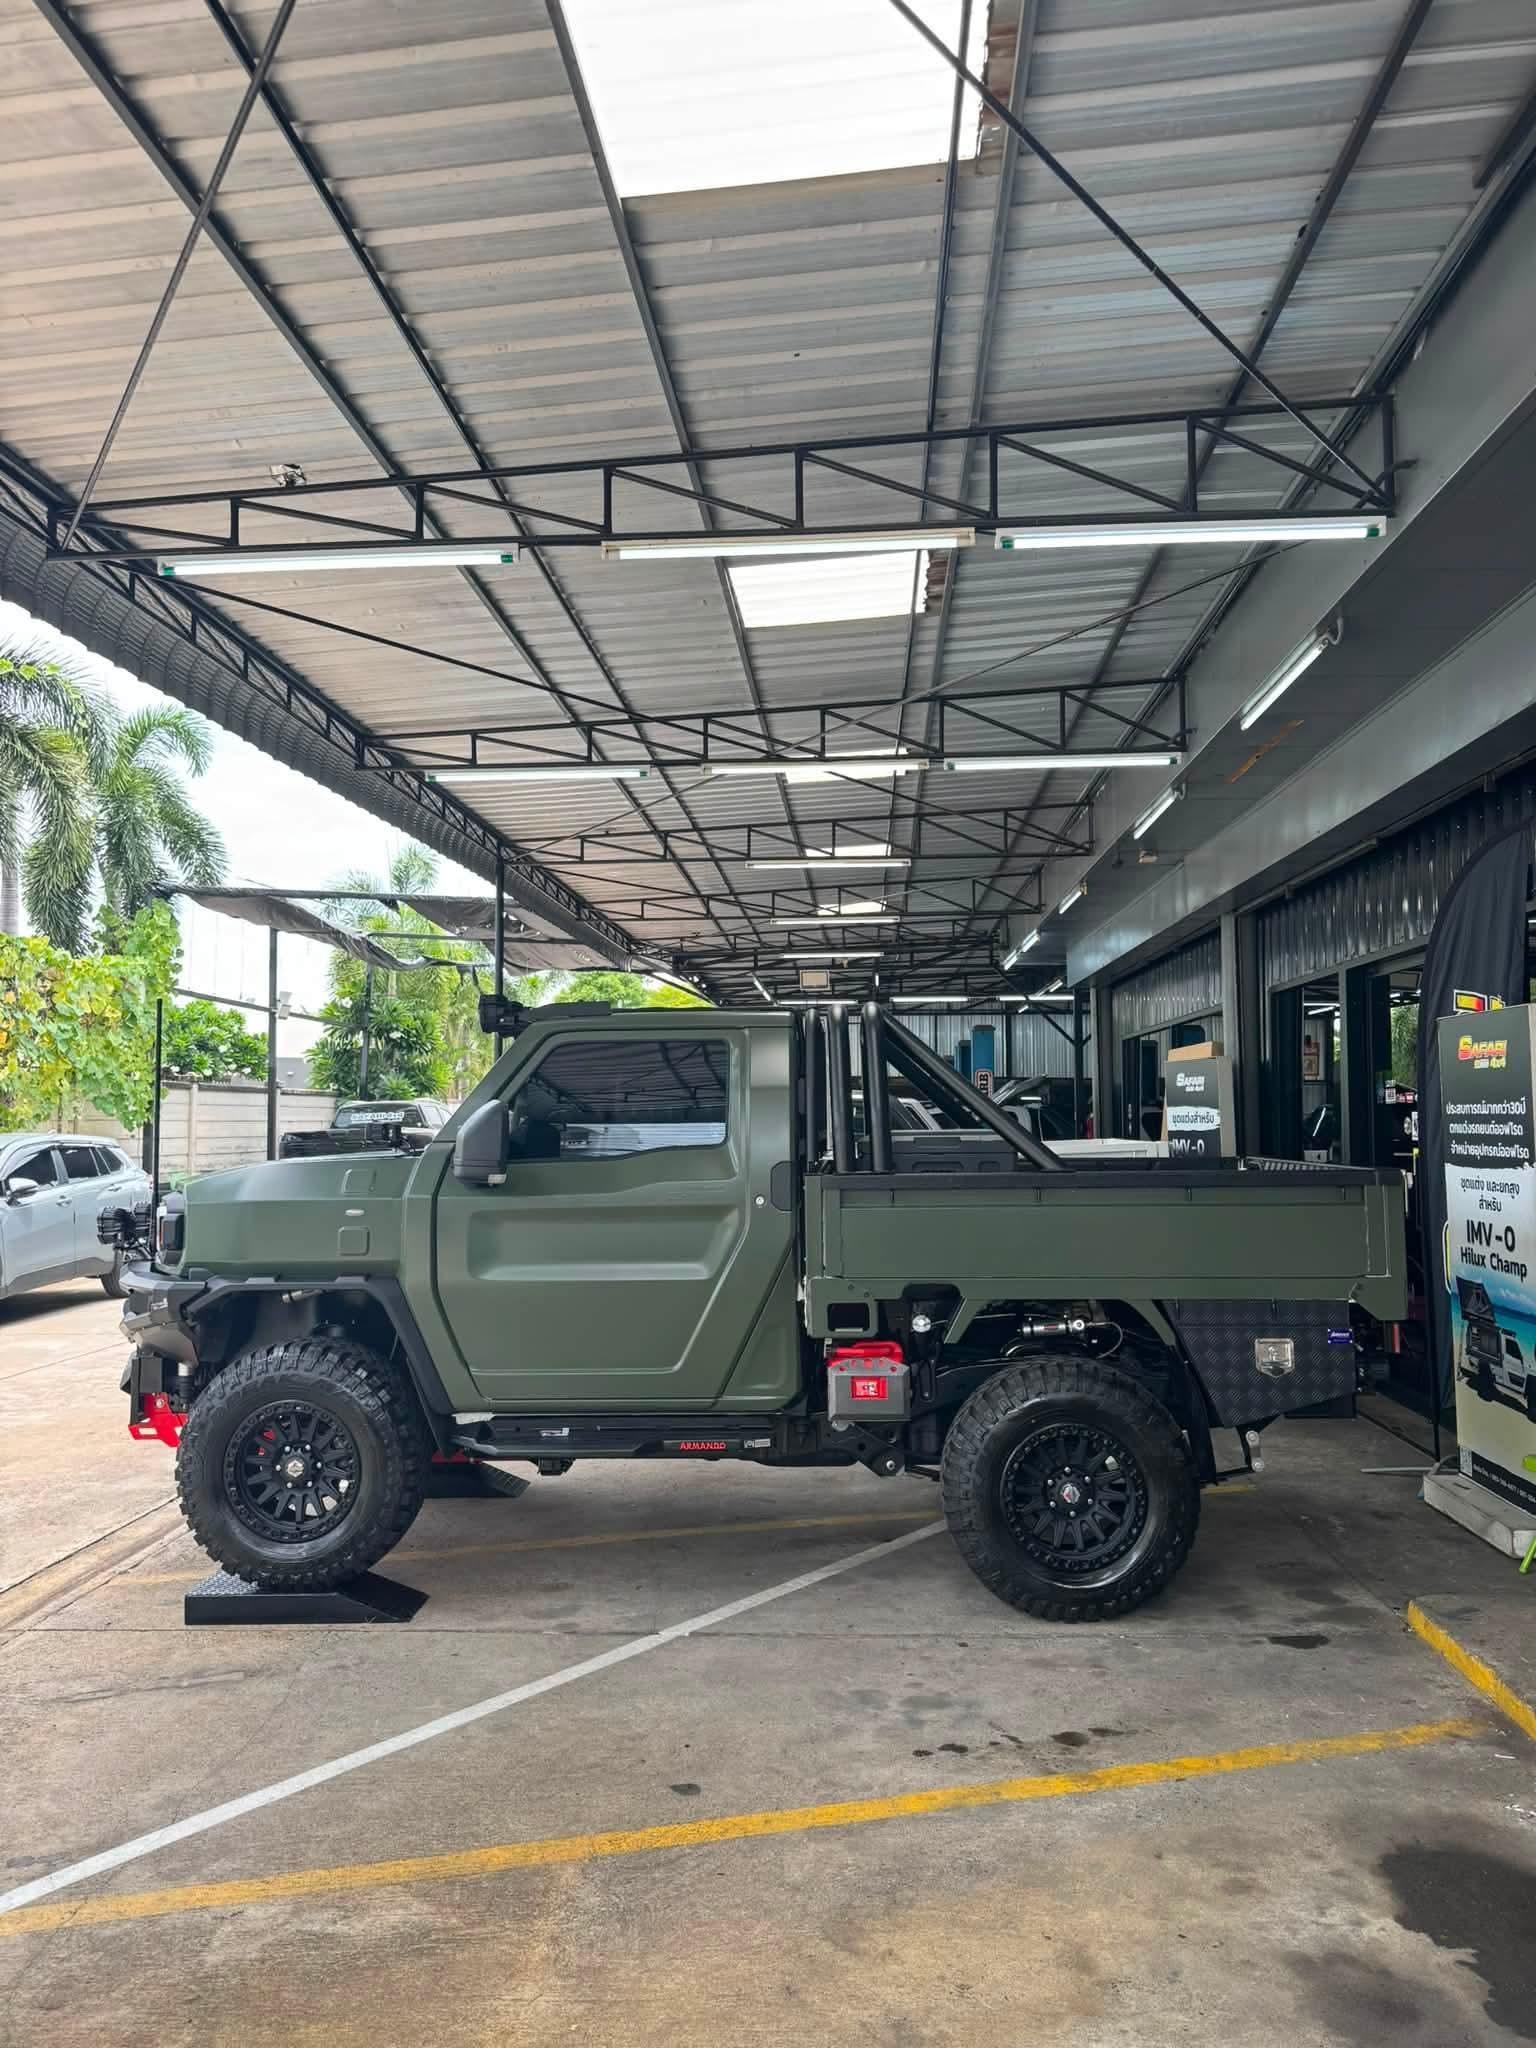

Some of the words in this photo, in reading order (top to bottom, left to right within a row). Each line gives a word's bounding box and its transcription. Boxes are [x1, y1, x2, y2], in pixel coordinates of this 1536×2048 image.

[1479, 1194, 1503, 1212] สำหรับ
[1460, 1246, 1487, 1269] Hilux
[1489, 1252, 1528, 1283] Champ
[680, 1440, 728, 1451] ARMANDO
